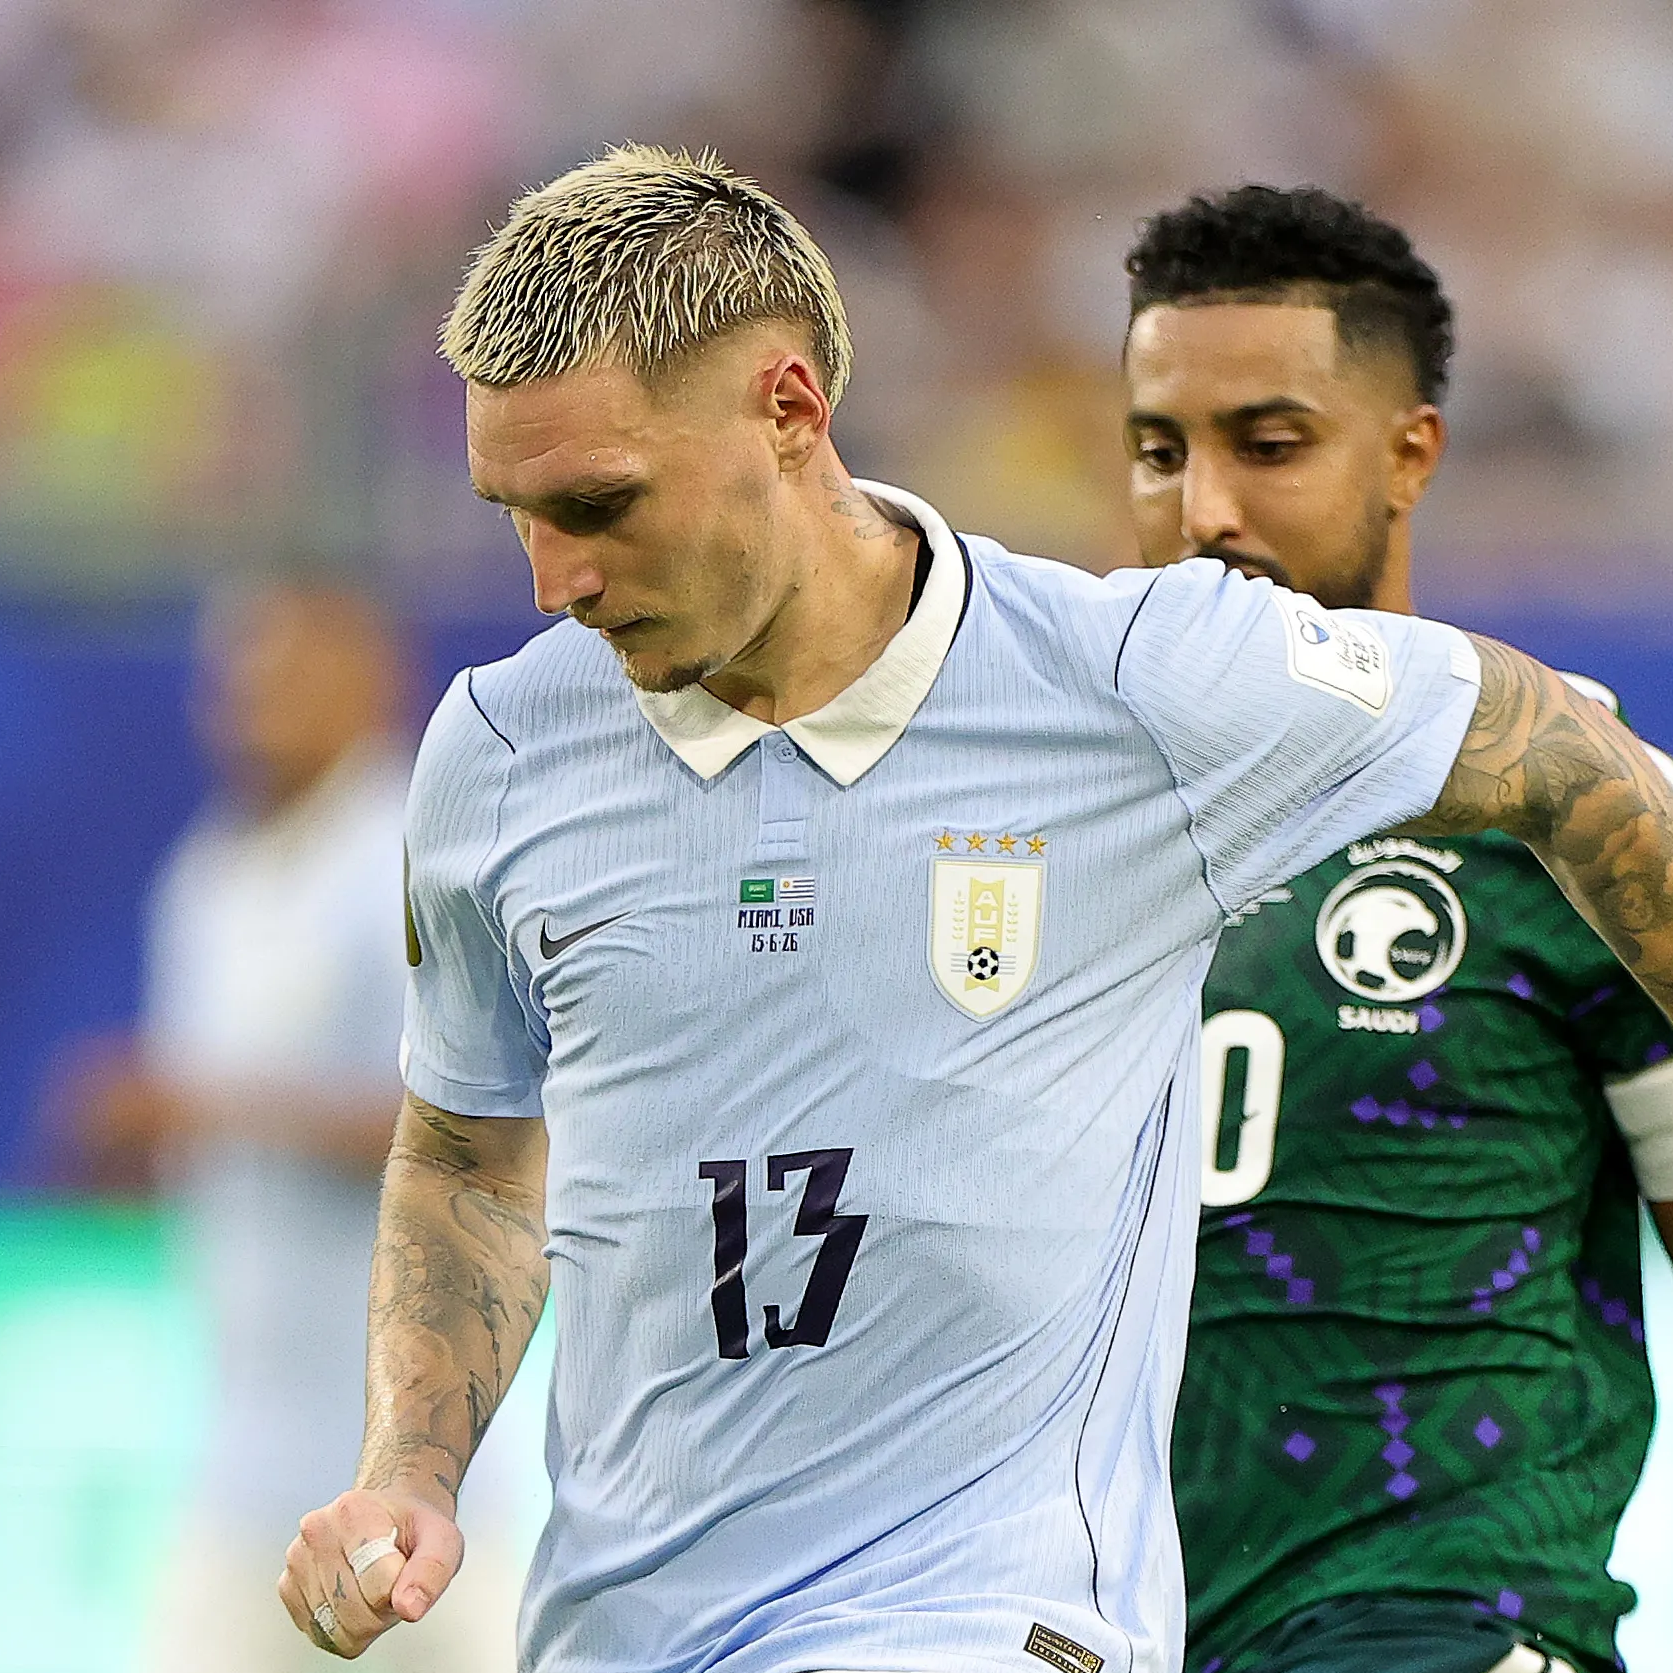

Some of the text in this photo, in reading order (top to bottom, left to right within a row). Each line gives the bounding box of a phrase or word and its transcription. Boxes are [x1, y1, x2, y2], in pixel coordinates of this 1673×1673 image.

[737, 907, 814, 929] MIAMI, USA
[973, 890, 999, 944] AUF
[698, 1147, 870, 1360] 13
